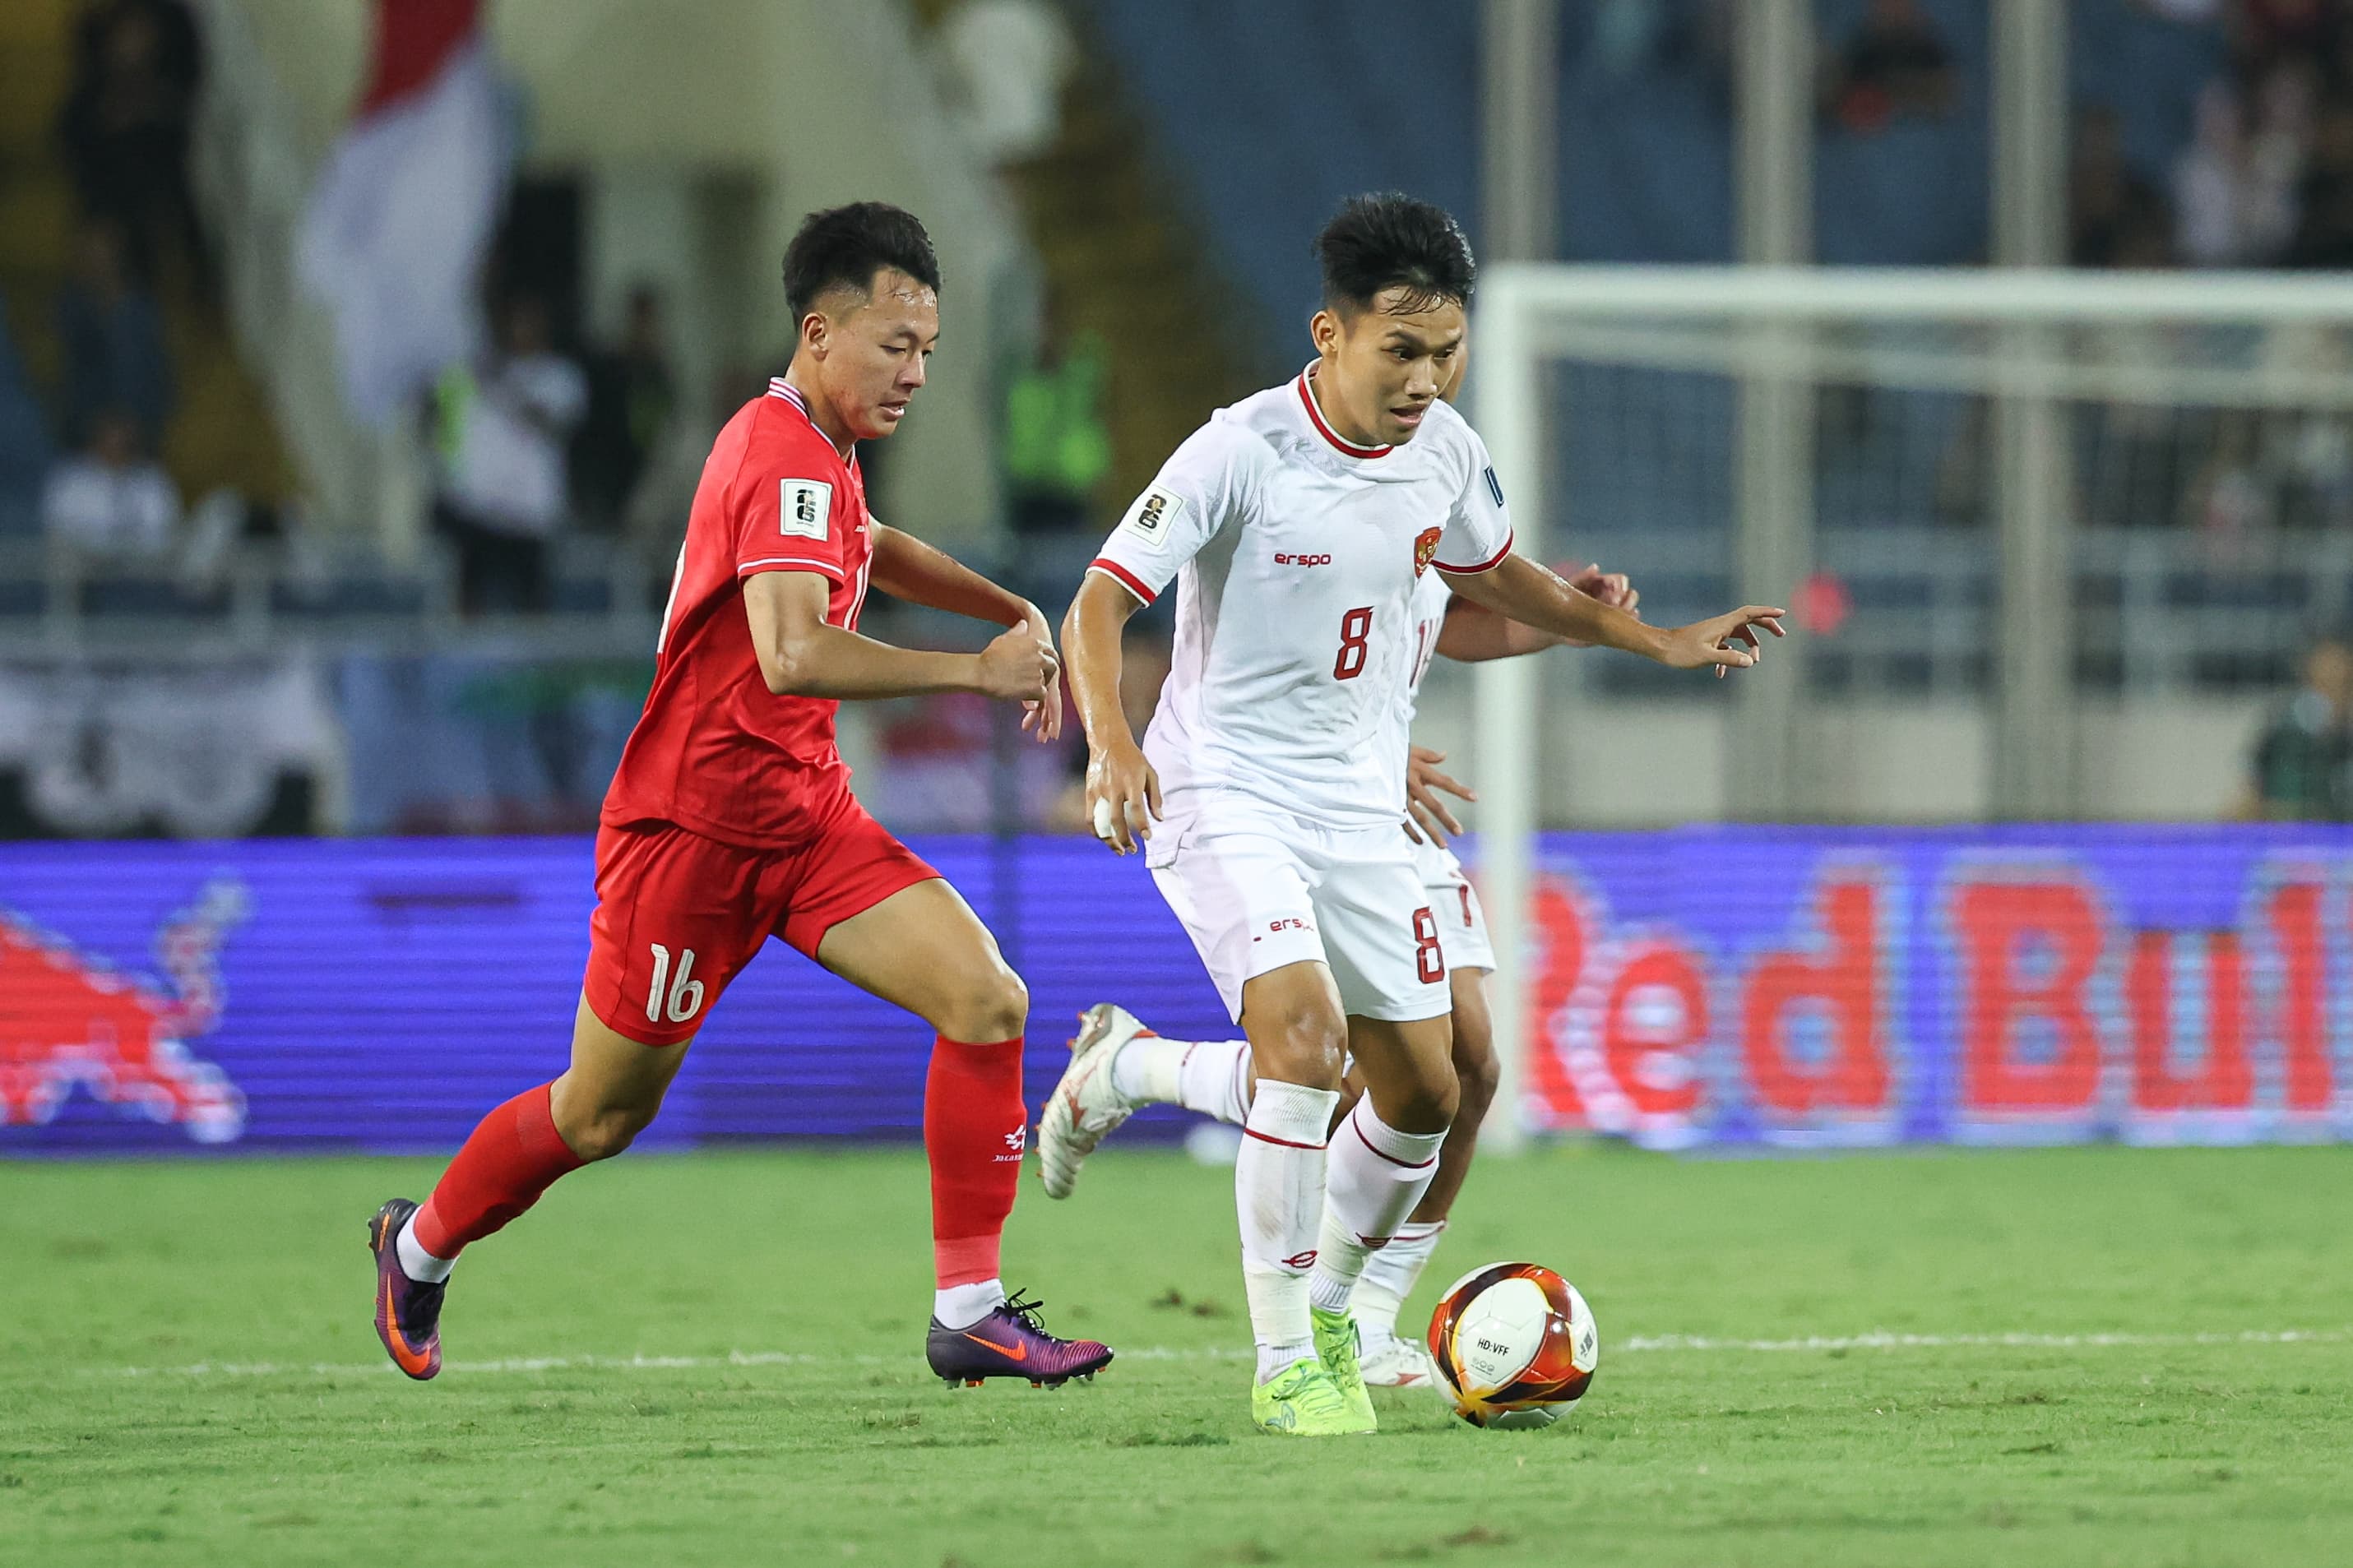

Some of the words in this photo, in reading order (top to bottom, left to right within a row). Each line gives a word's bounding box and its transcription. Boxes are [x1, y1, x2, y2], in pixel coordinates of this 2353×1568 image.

[1274, 553, 1331, 568] erspo
[1333, 605, 1374, 681] 8
[1270, 918, 1314, 932] ers
[1412, 905, 1445, 984] 8
[646, 942, 705, 1023] 16
[1951, 880, 2353, 1113] Bul
[1476, 1337, 1510, 1357] HD:VFF
